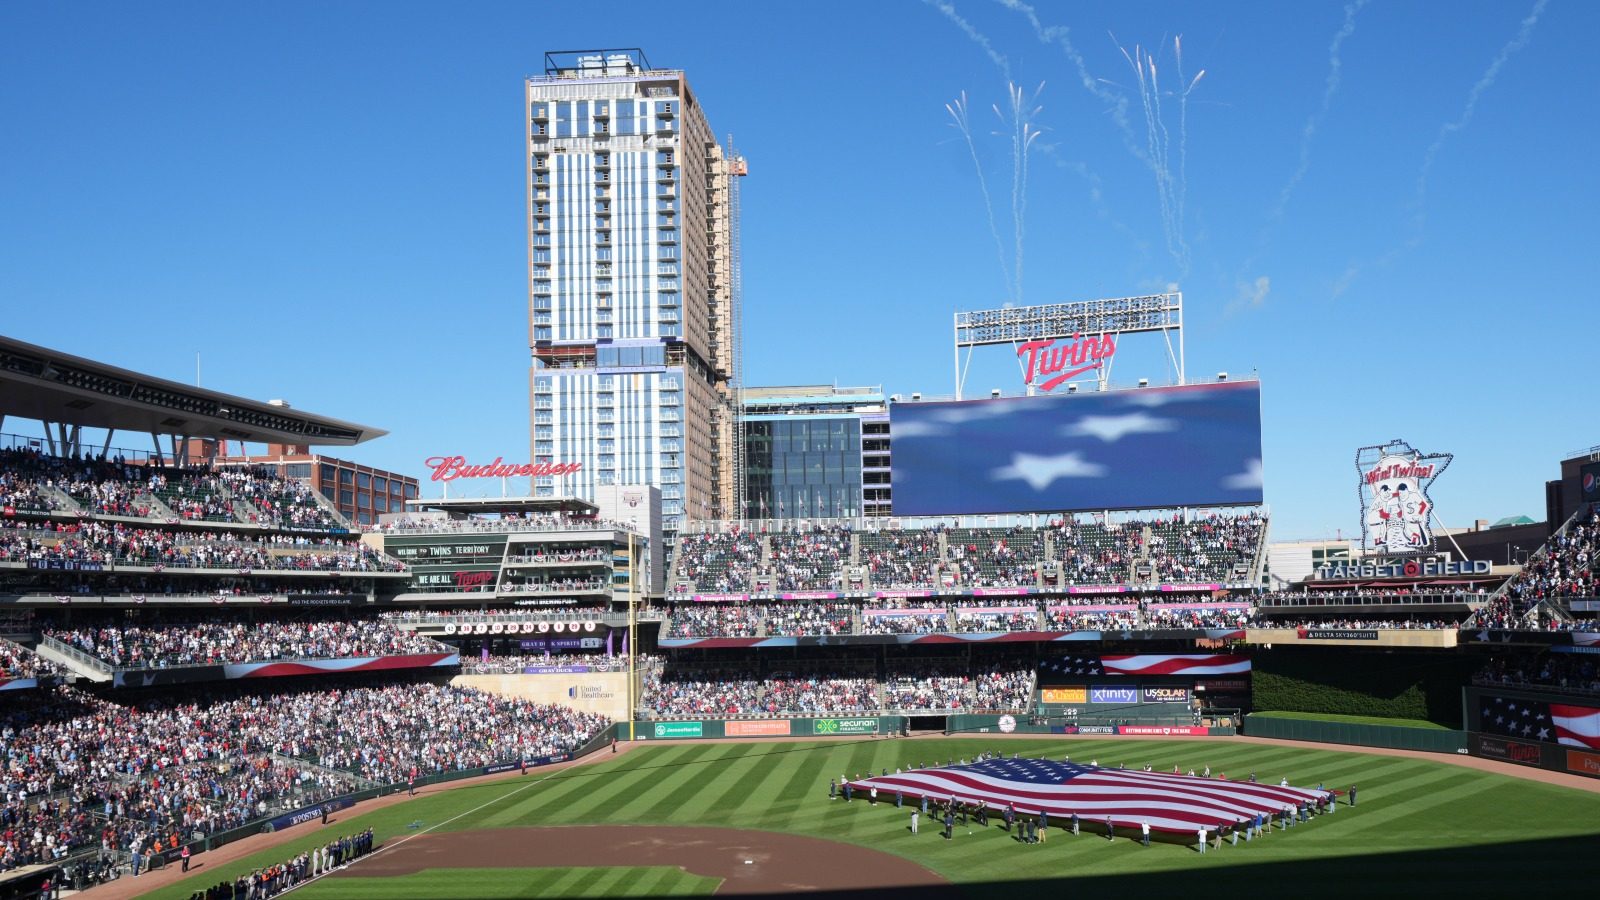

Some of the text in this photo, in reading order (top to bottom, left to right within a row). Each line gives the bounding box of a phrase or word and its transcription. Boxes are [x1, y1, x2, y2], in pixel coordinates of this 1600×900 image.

[1017, 331, 1115, 391] Twins
[425, 456, 582, 482] Budweiser
[1366, 461, 1434, 483] Win! Twins!
[430, 547, 452, 555] TWINS
[1322, 560, 1492, 578] TARGET FIELD
[454, 570, 493, 592] Twins
[1095, 687, 1133, 701] xfinity
[298, 804, 332, 823] POSTSEAN
